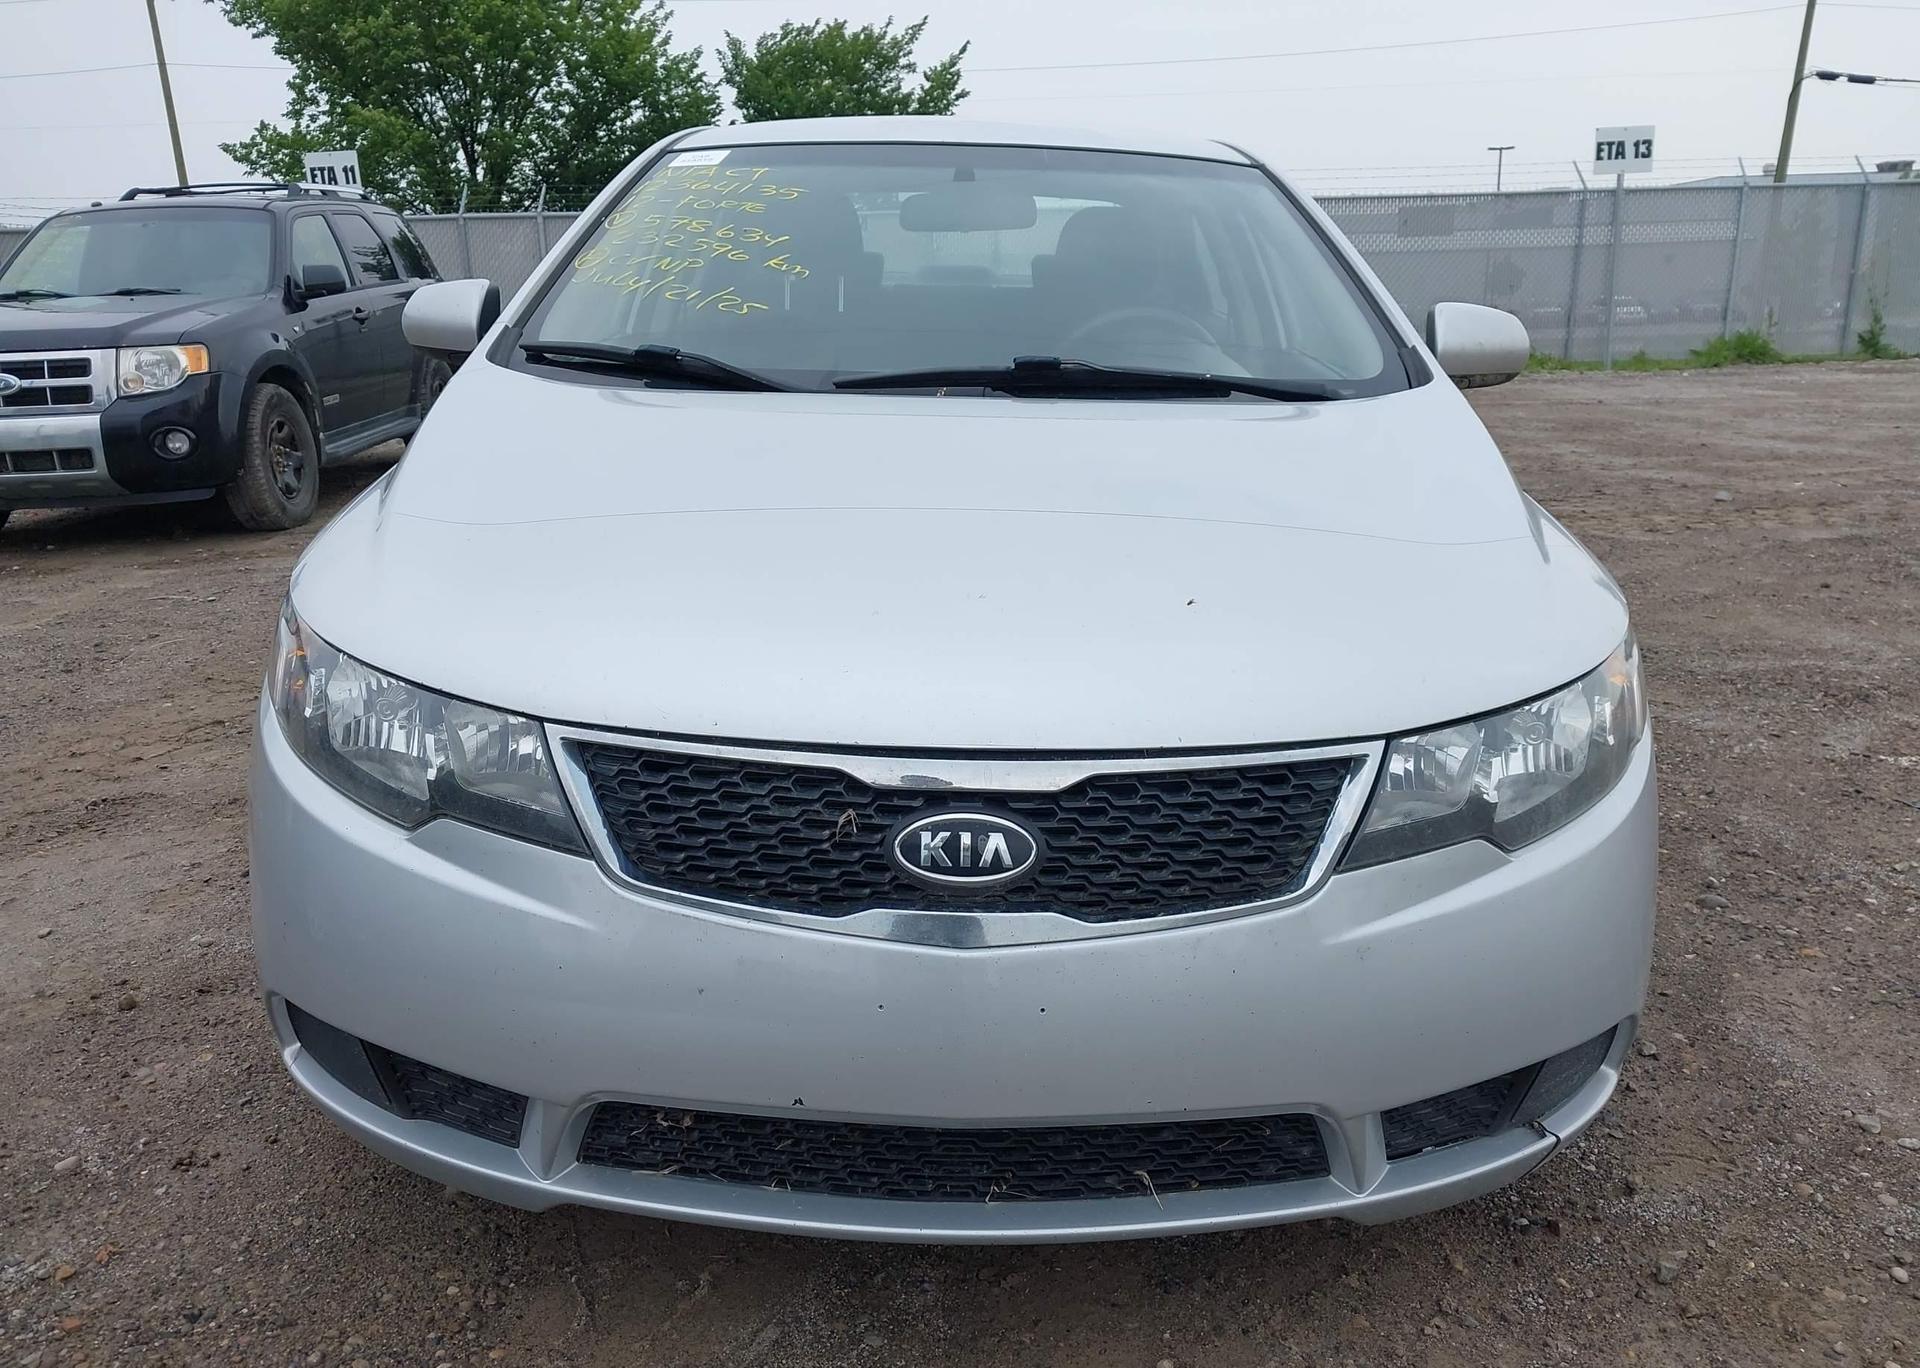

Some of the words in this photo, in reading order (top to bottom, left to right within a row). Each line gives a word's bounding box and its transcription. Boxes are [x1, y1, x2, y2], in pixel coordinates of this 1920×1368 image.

[1596, 140, 1626, 161] ETA
[1633, 138, 1653, 159] 13
[309, 166, 339, 185] ETA
[342, 165, 357, 185] 11
[640, 214, 790, 247] 578634
[763, 253, 810, 279] km
[919, 831, 1013, 868] KIA
